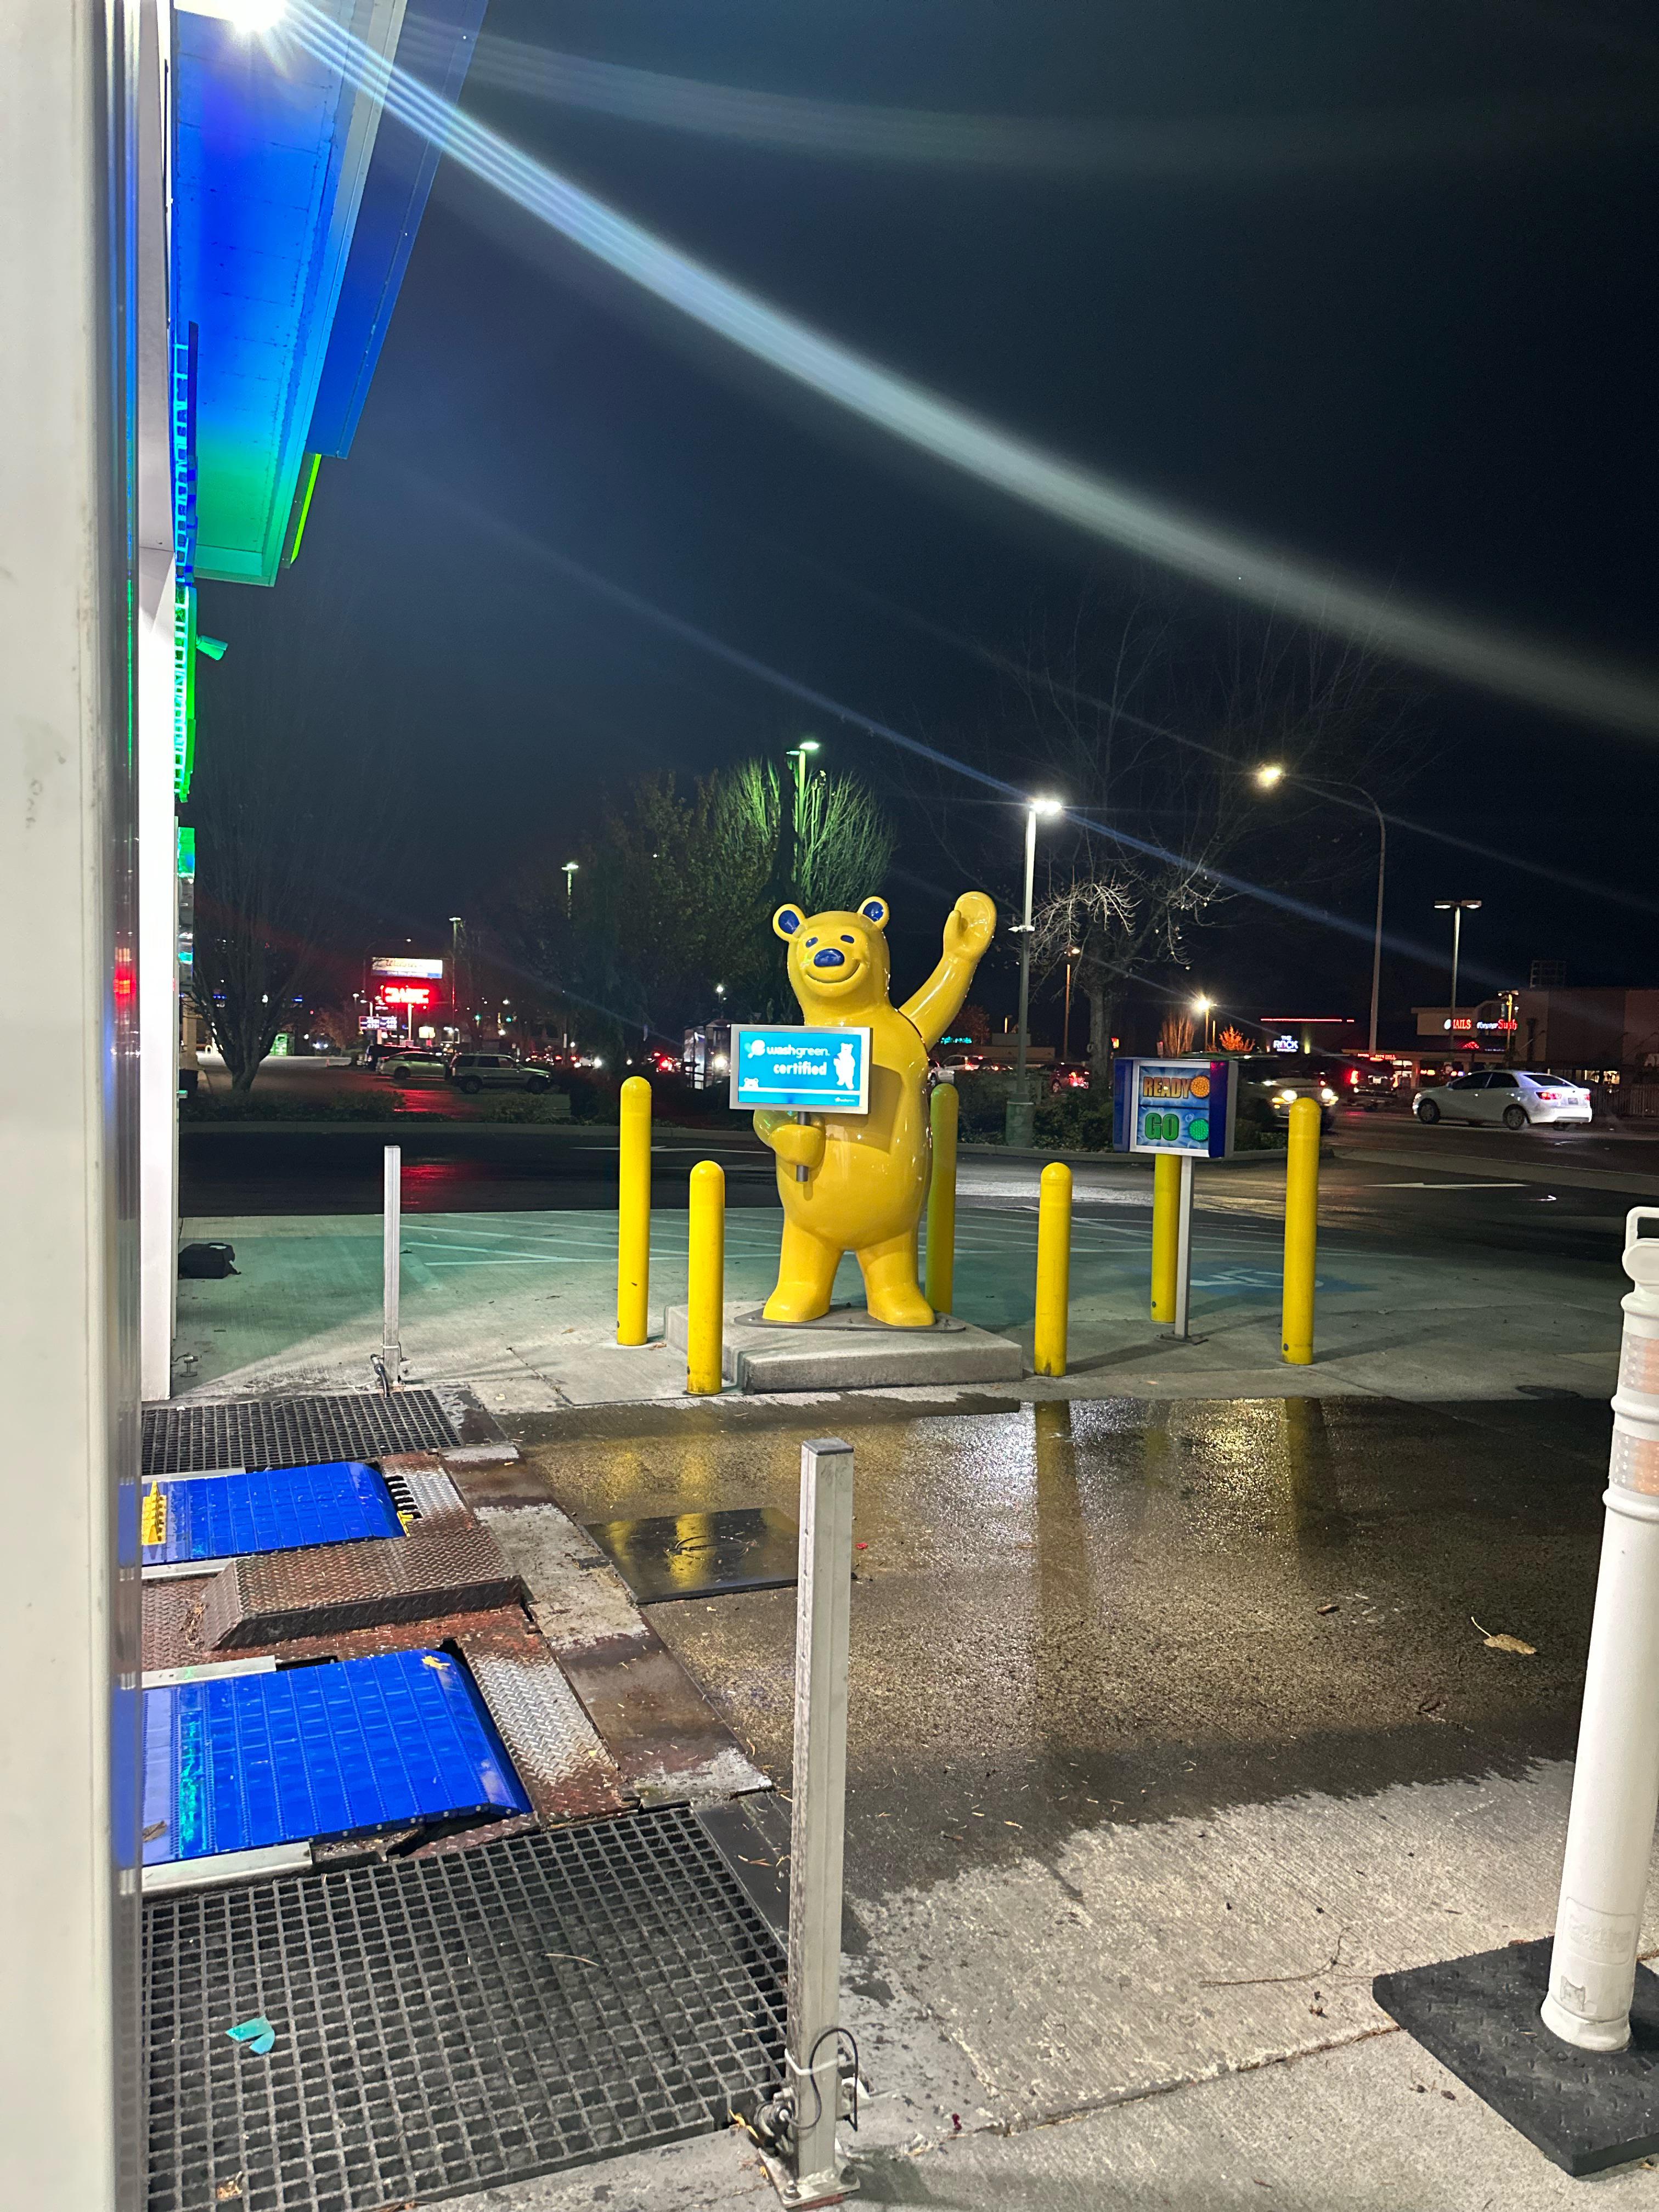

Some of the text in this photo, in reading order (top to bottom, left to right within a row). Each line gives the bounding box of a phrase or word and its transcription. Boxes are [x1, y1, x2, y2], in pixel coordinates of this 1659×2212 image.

[1273, 1040, 1299, 1049] ROCK
[773, 1060, 827, 1076] certified
[1143, 1076, 1192, 1099] READY
[1145, 1112, 1180, 1141] GO
